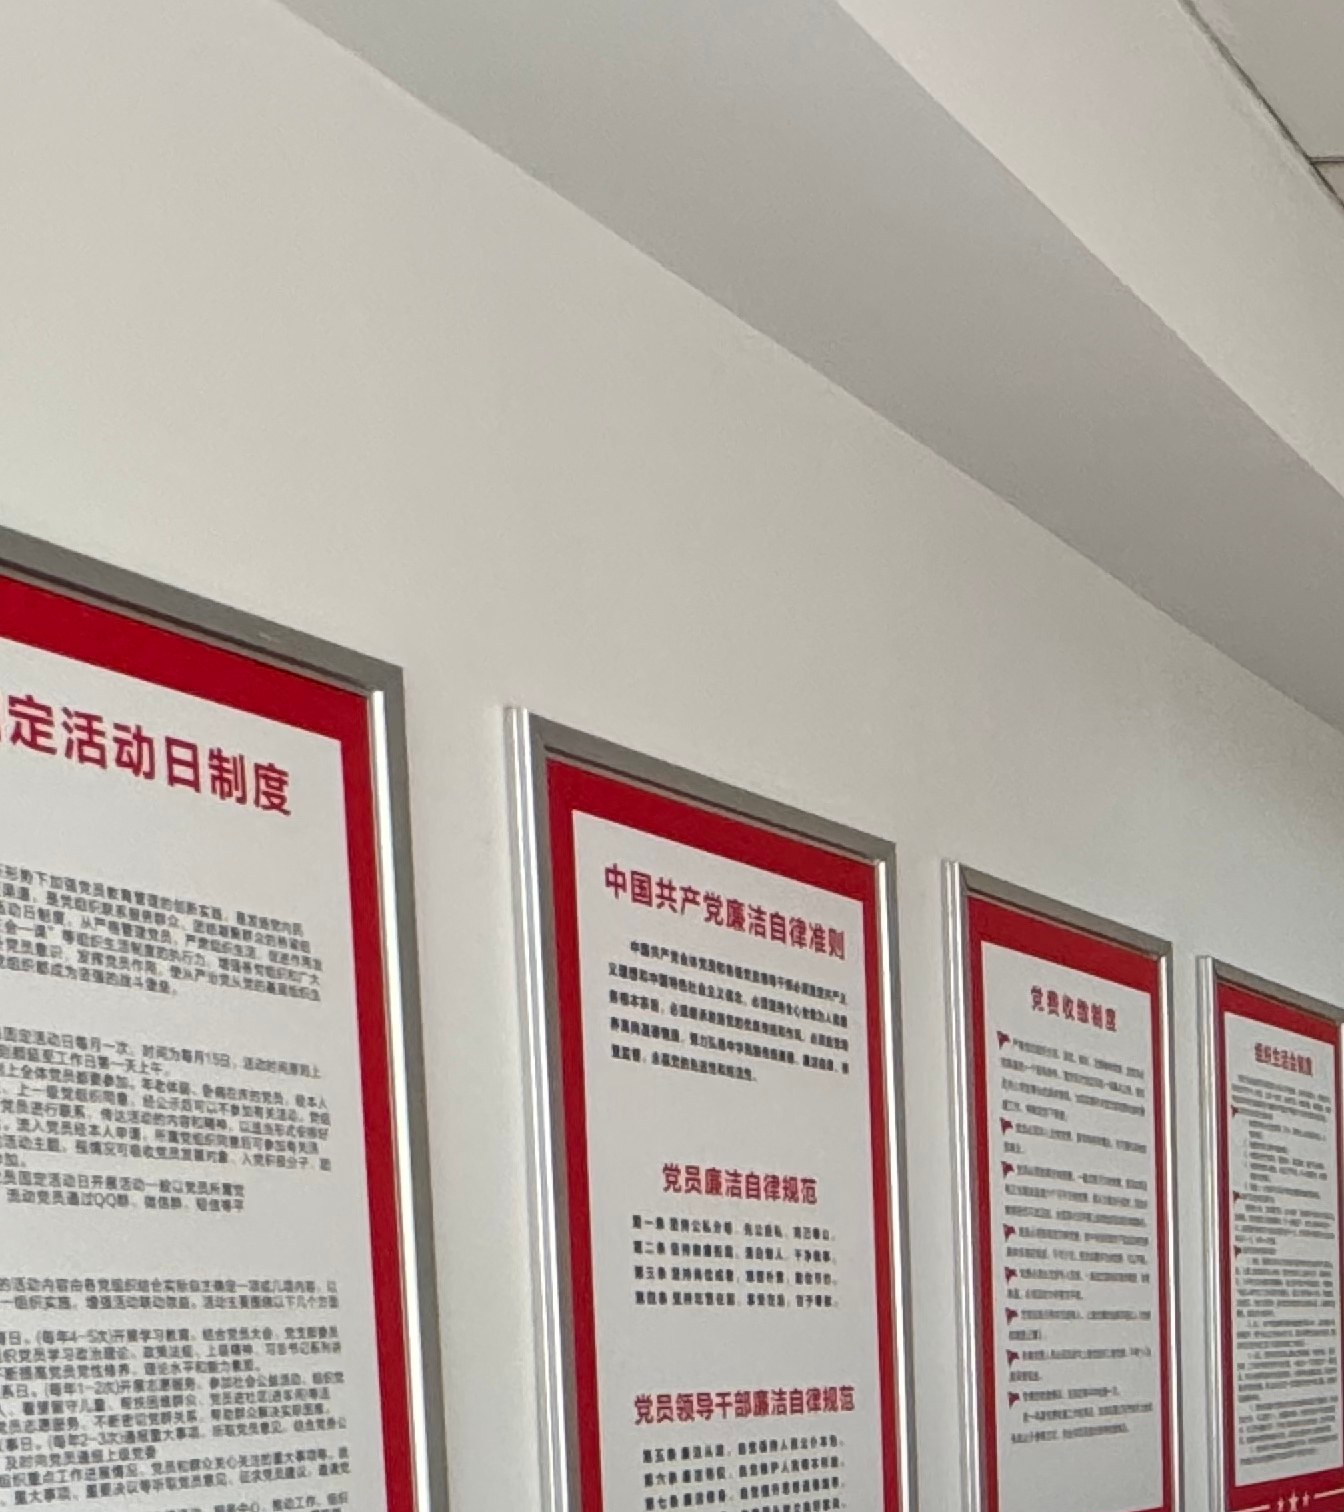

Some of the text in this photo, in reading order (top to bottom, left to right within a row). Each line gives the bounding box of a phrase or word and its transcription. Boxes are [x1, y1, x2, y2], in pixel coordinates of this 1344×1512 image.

[0, 694, 291, 816] 定活动日制度
[604, 863, 846, 960] 中国共产党廉洁自律准则
[661, 1162, 818, 1207] 党员廉洁自律规范
[634, 1385, 856, 1425] 党员领导干部廉洁自律规范
